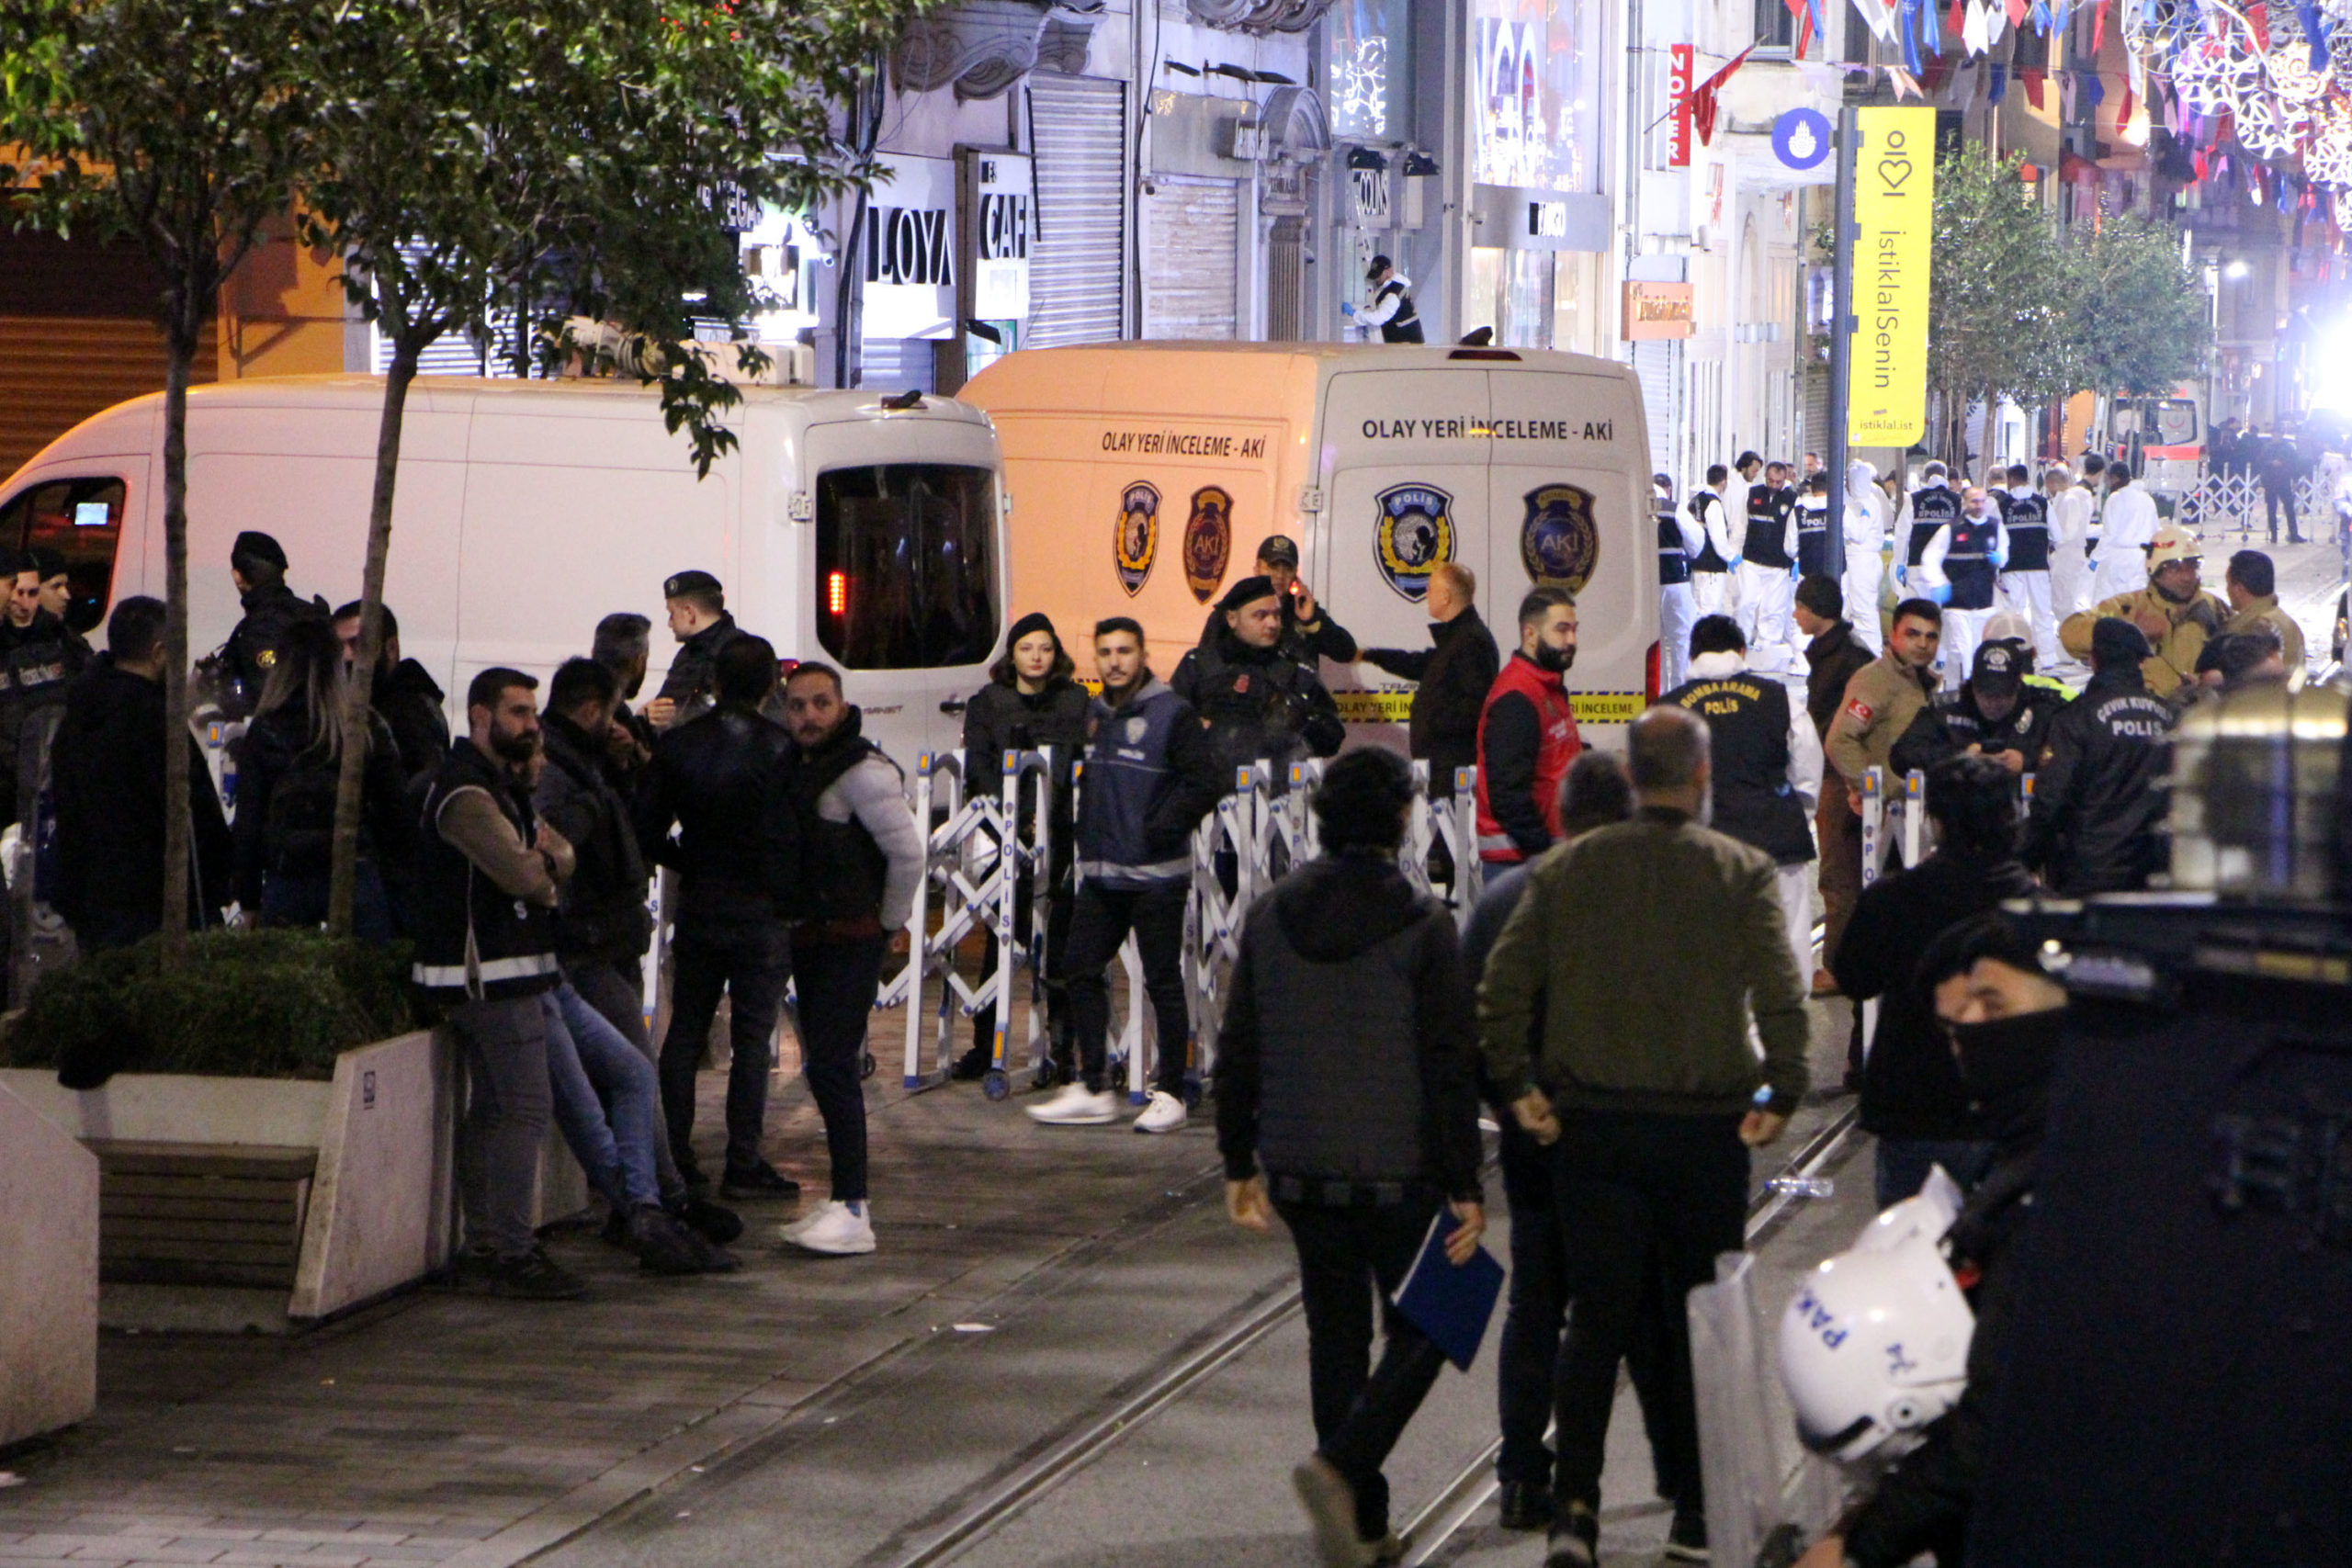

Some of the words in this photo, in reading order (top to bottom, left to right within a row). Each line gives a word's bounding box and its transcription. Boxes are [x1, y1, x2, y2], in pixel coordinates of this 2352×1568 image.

[1667, 52, 1685, 160] NOTER
[867, 207, 955, 286] LOYA
[1874, 231, 1906, 388] istiklalSenin
[1363, 420, 1416, 439] OLAY
[1423, 416, 1464, 439] YERİ
[1470, 416, 1567, 440] İNCELEME
[1583, 419, 1613, 440] AKİ
[1860, 420, 1913, 431] istiklal.ist
[1102, 431, 1136, 452] OLAY
[1137, 430, 1167, 454] YERİ
[1166, 430, 1232, 457] İNCELEME
[1240, 434, 1267, 458] AKİ
[1394, 491, 1434, 506] POLİS
[1337, 702, 1367, 713] OLAY
[1582, 699, 1634, 714] İNCELEME
[1680, 682, 1720, 708] BOMBA
[1721, 682, 1761, 702] ARAMA
[1704, 697, 1739, 716] POLİS
[1001, 820, 1012, 928] POLIS
